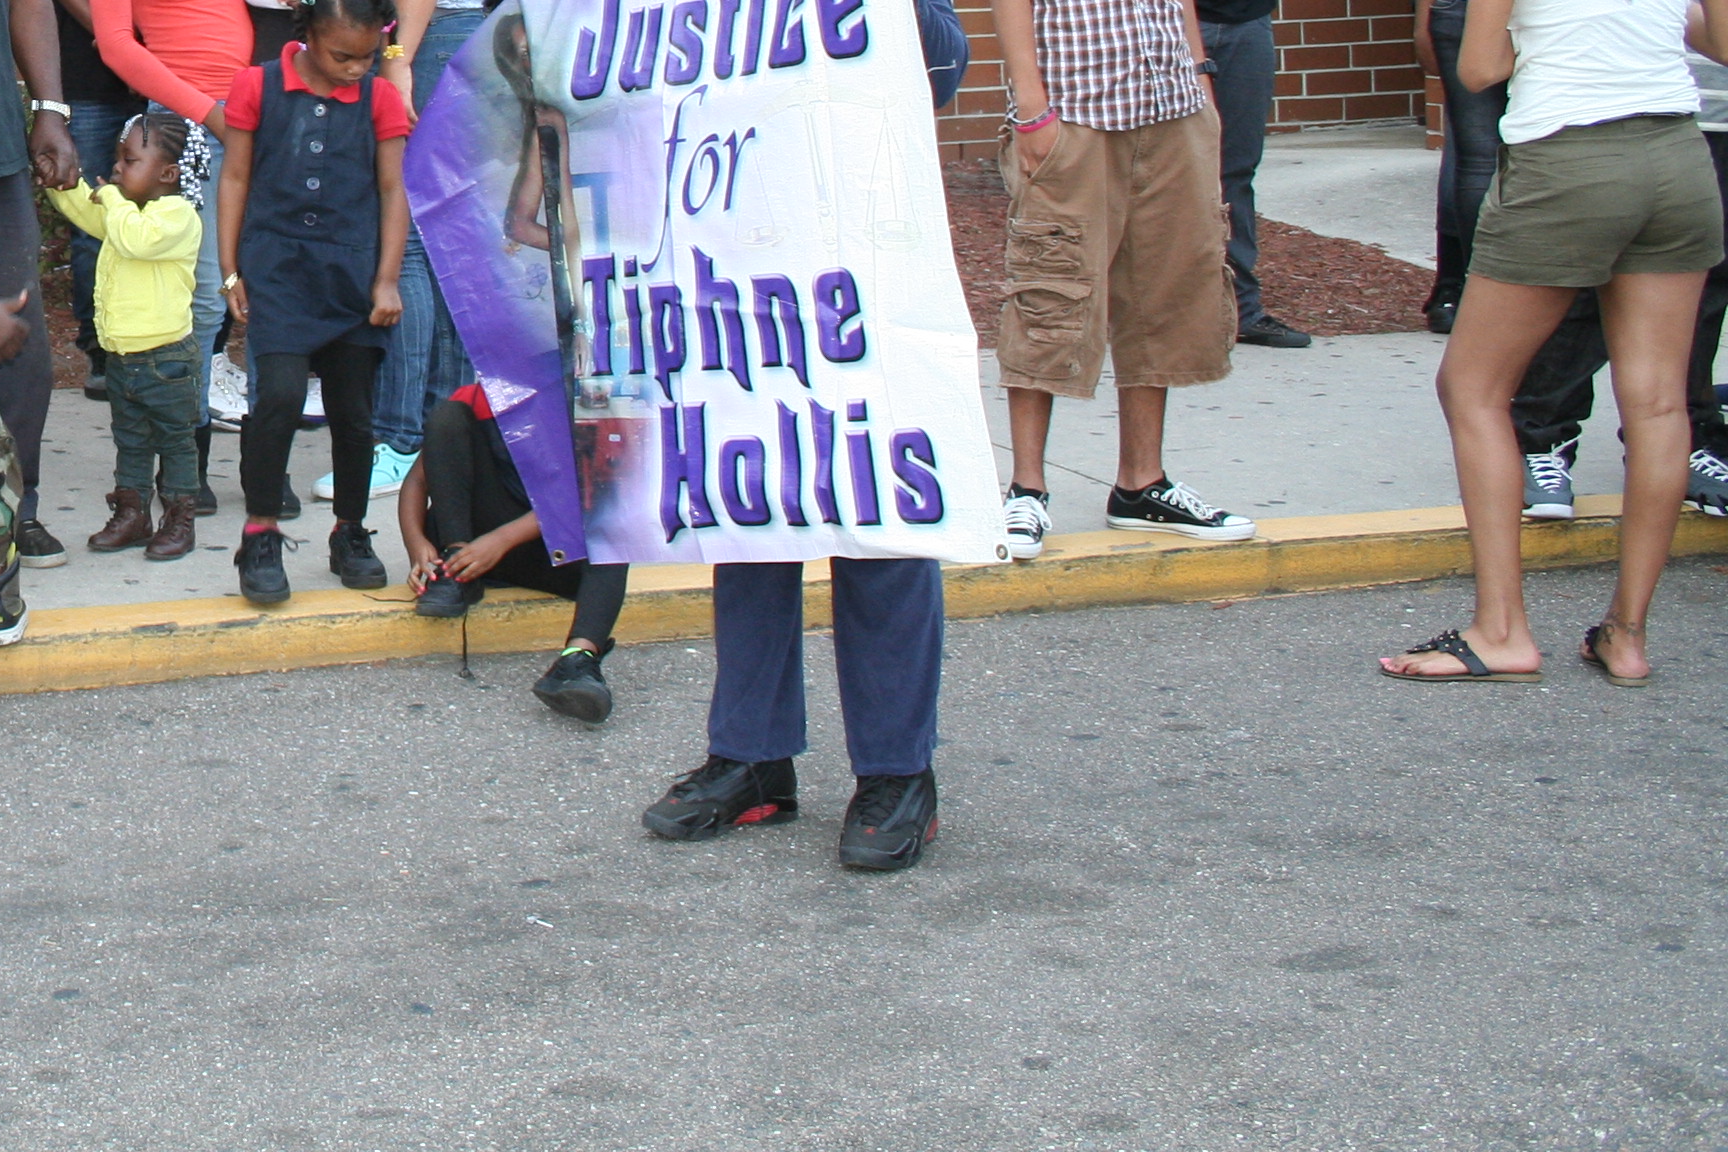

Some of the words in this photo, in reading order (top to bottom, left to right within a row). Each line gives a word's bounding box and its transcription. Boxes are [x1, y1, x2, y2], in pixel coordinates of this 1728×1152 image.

[641, 84, 756, 274] for
[581, 244, 867, 401] Tiphne
[659, 397, 944, 545] Hollis
